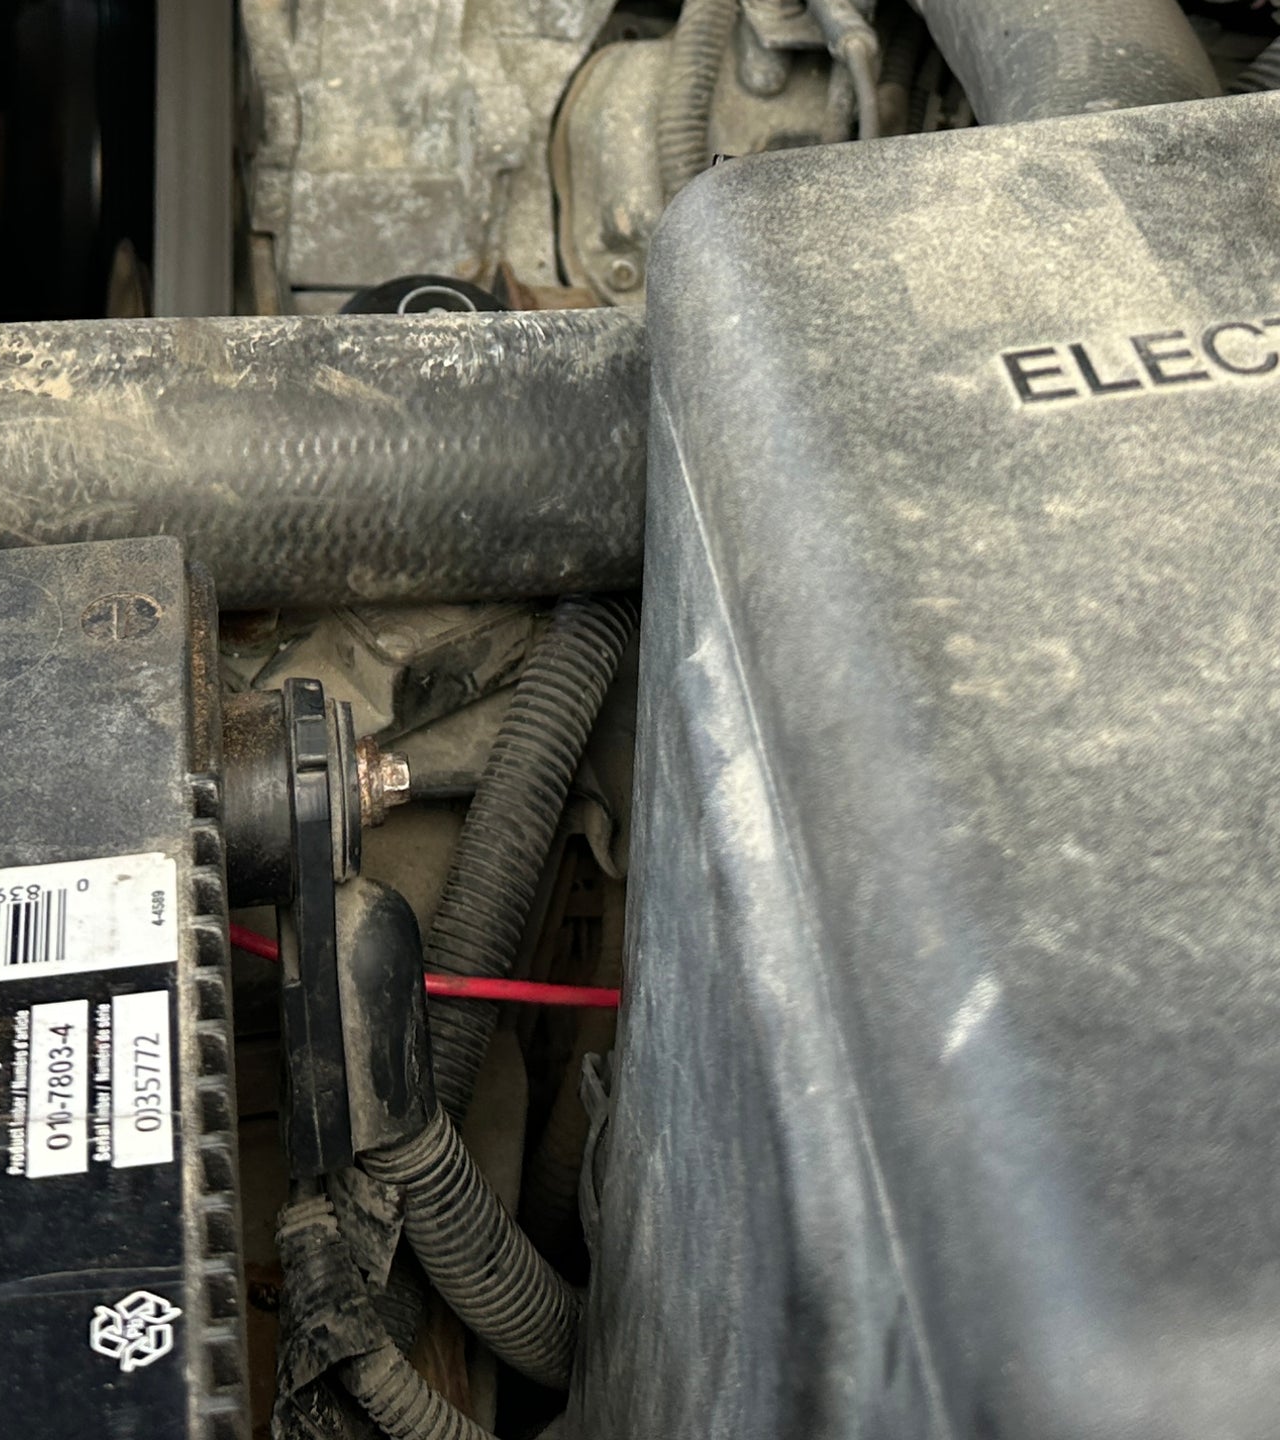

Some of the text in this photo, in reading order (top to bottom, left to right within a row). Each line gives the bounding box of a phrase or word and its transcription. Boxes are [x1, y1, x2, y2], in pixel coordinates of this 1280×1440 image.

[76, 878, 89, 892] 0
[150, 889, 164, 926] 4-4589
[95, 1028, 113, 1041] de
[43, 1022, 77, 1151] 010-7803-4
[5, 1127, 26, 1175] Product
[92, 1123, 111, 1161] Serial
